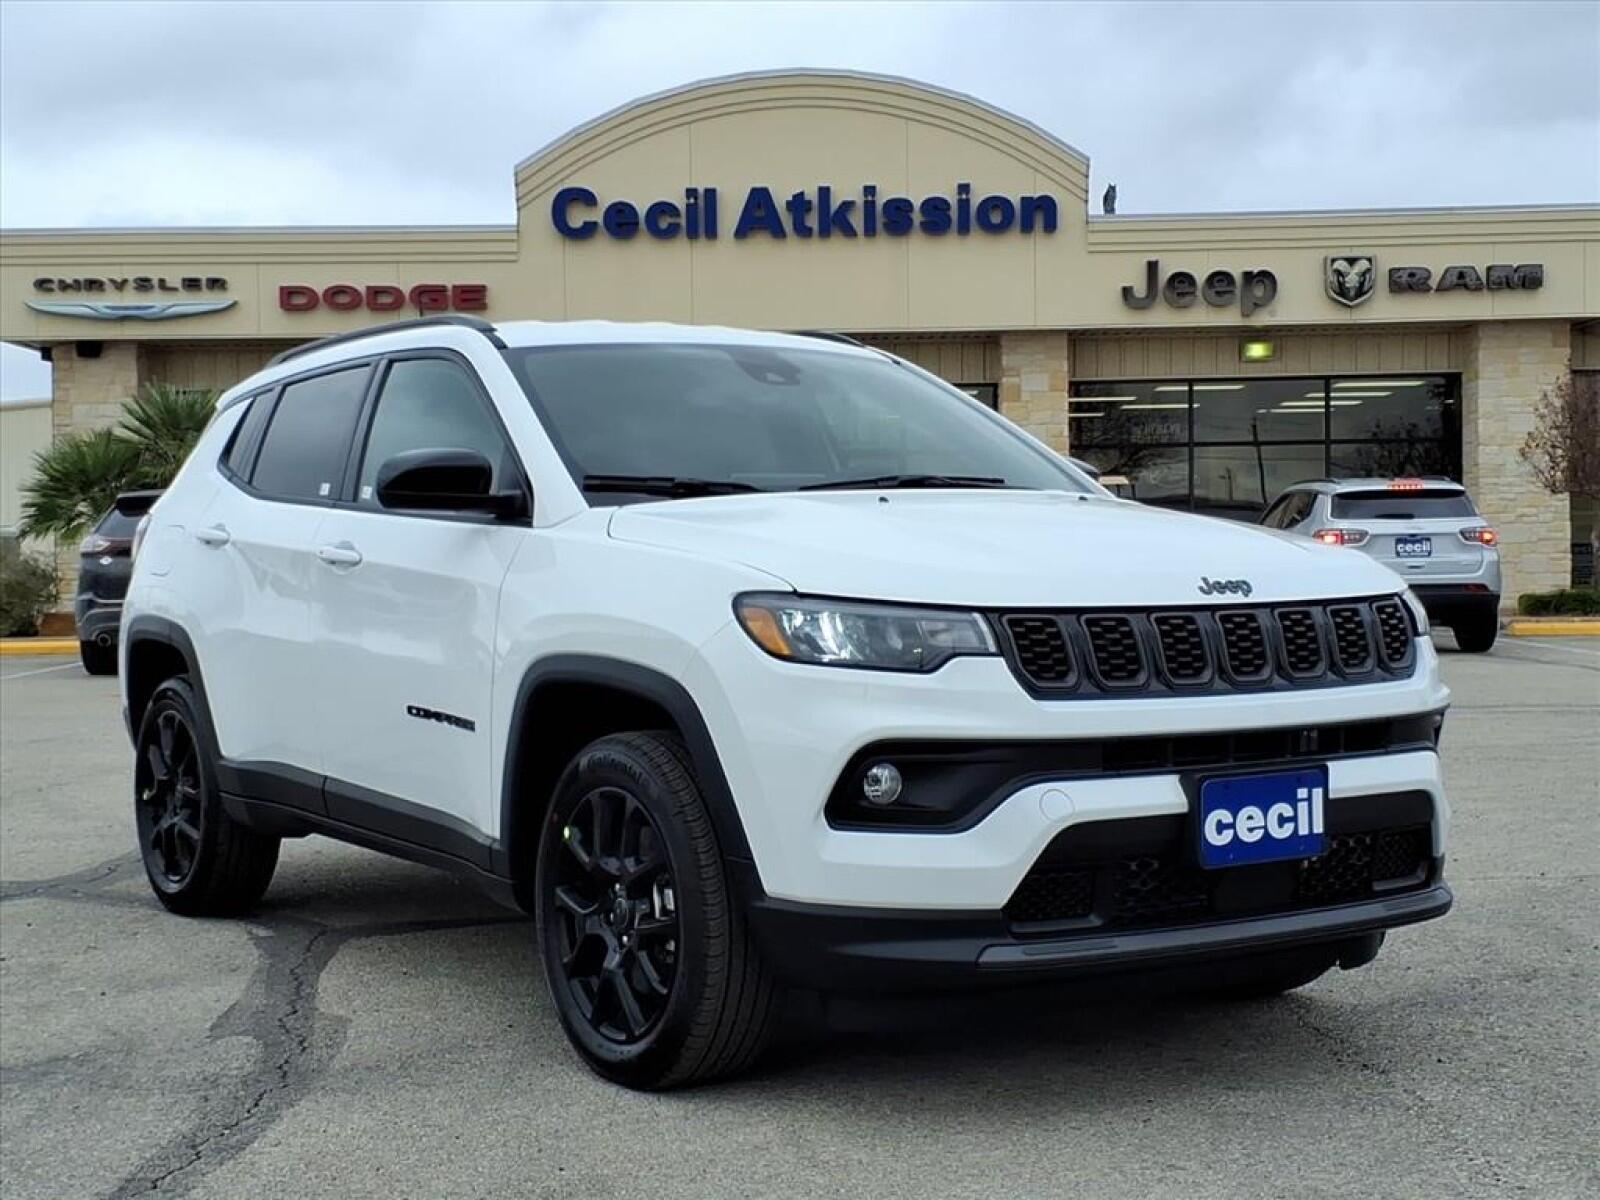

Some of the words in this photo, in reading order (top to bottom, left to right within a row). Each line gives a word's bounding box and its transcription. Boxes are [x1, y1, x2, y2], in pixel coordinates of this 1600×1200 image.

[551, 187, 717, 240] Cecil
[734, 183, 1058, 238] Atkission
[33, 276, 229, 292] CHRYSLER
[1121, 259, 1278, 317] Jeep
[1388, 263, 1544, 294] RAM
[279, 284, 488, 313] DODGE
[1396, 540, 1431, 553] cecil
[1198, 576, 1252, 597] Jeep
[1204, 787, 1324, 846] cecil
